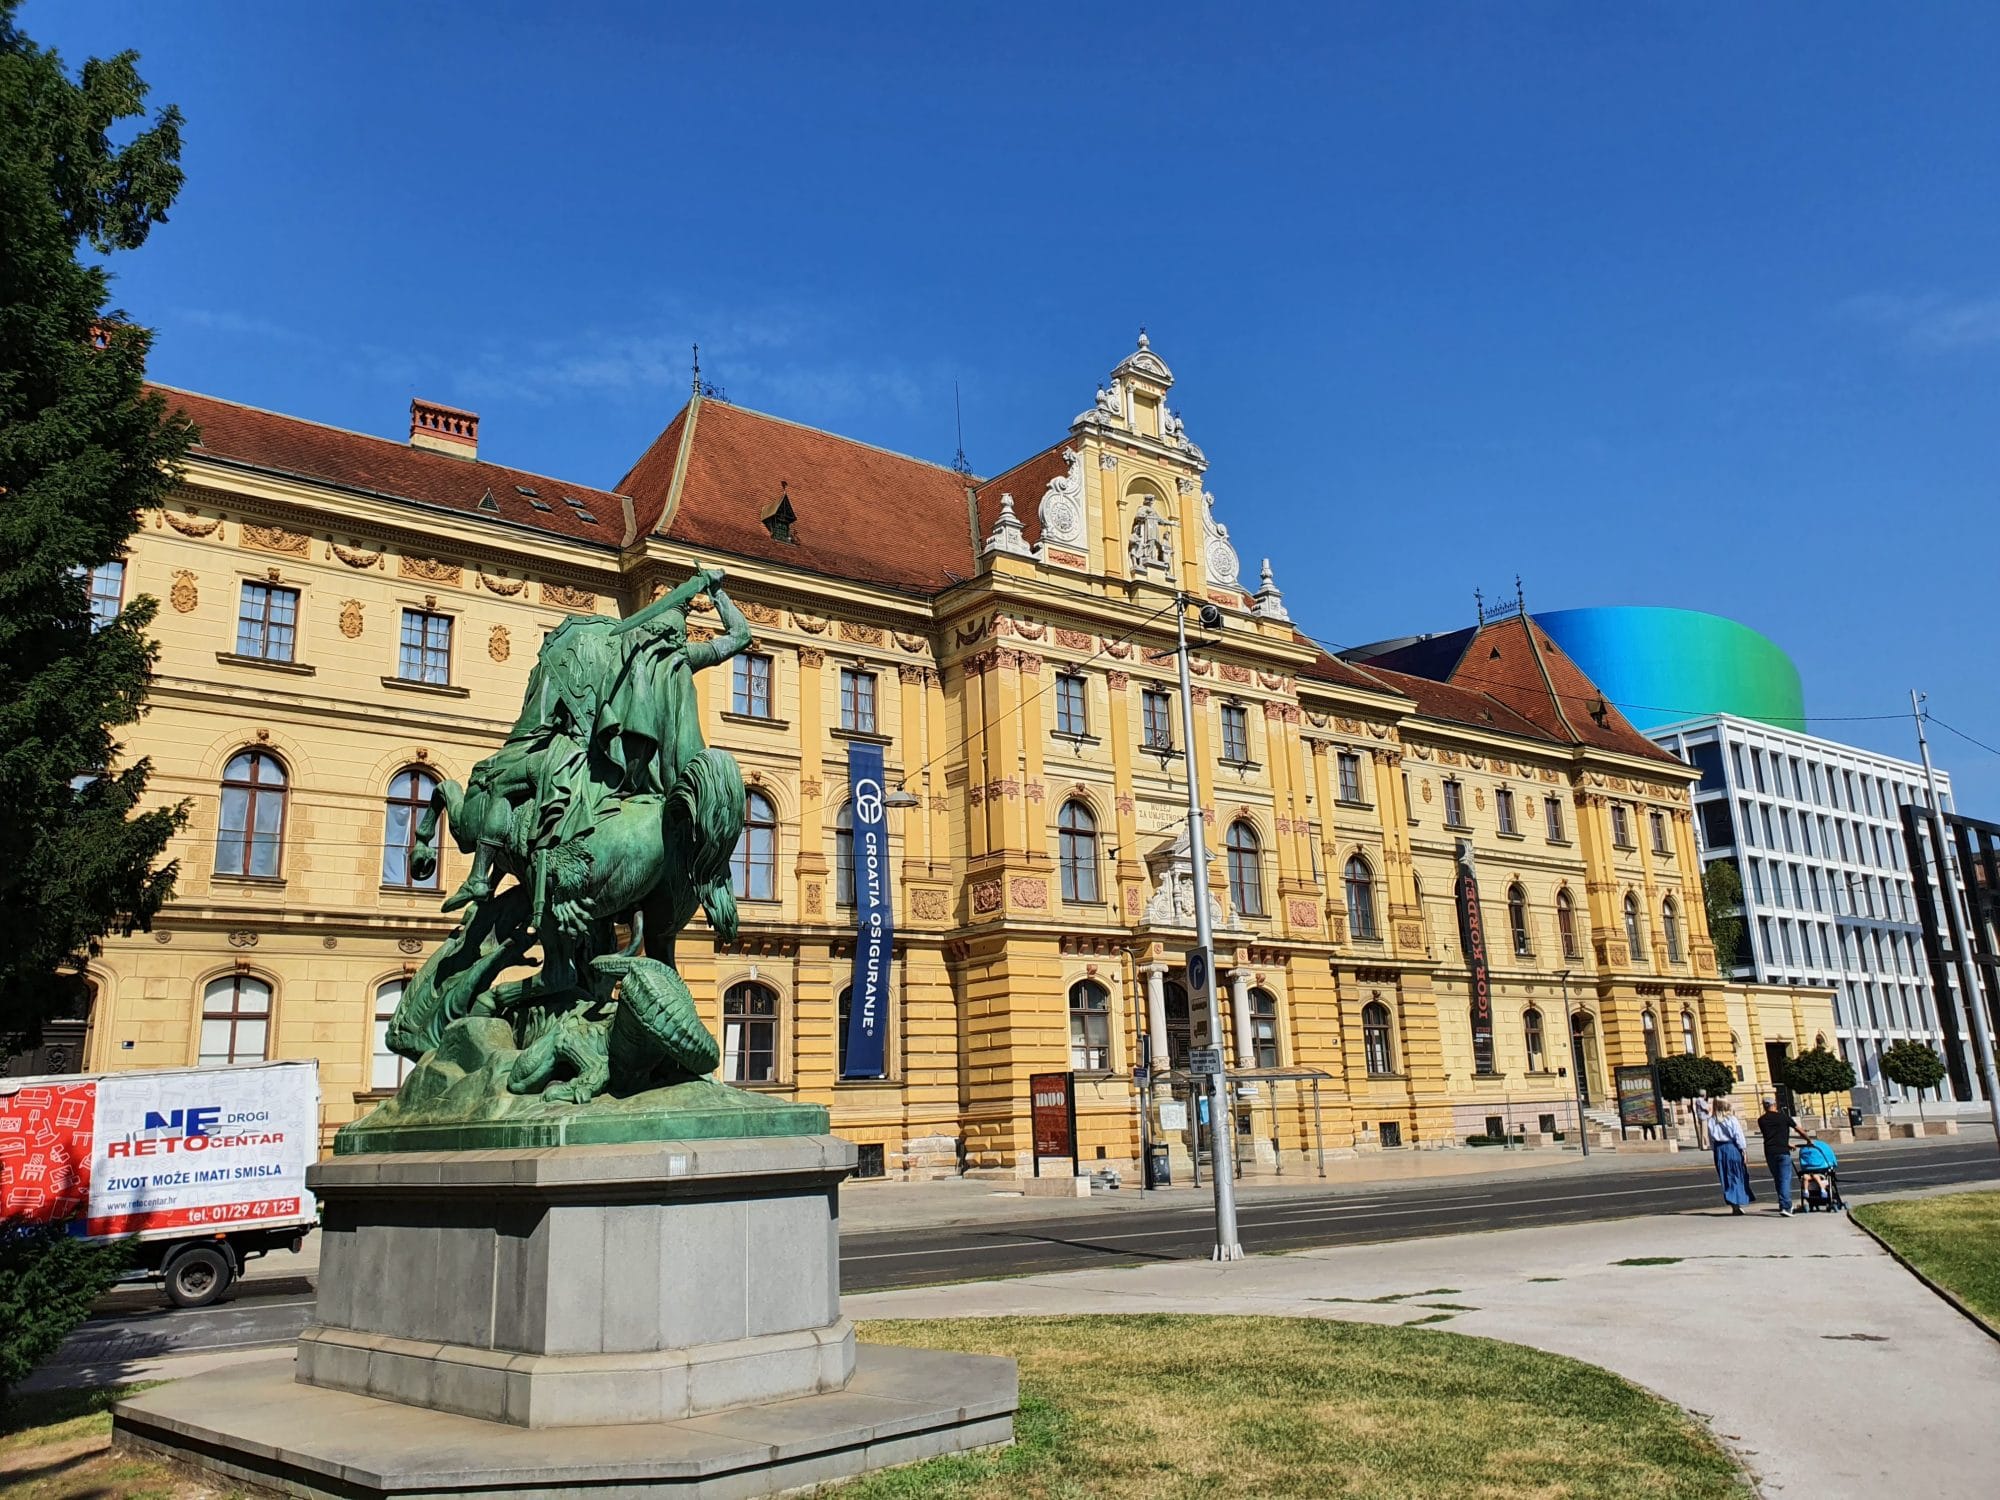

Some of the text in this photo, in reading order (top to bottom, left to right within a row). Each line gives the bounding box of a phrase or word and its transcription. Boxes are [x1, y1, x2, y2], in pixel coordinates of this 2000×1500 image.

[865, 832, 880, 908] CROATIA
[1464, 876, 1483, 960] KORDEJ
[1476, 966, 1489, 1019] IGOR
[145, 1107, 269, 1137] NE DROGI
[107, 1164, 282, 1191] ŽIVOT MOŽE IMATI SMISLA
[107, 1196, 177, 1210] www.retocentar.hr
[188, 1200, 295, 1222] tel. 01/29 47 125
